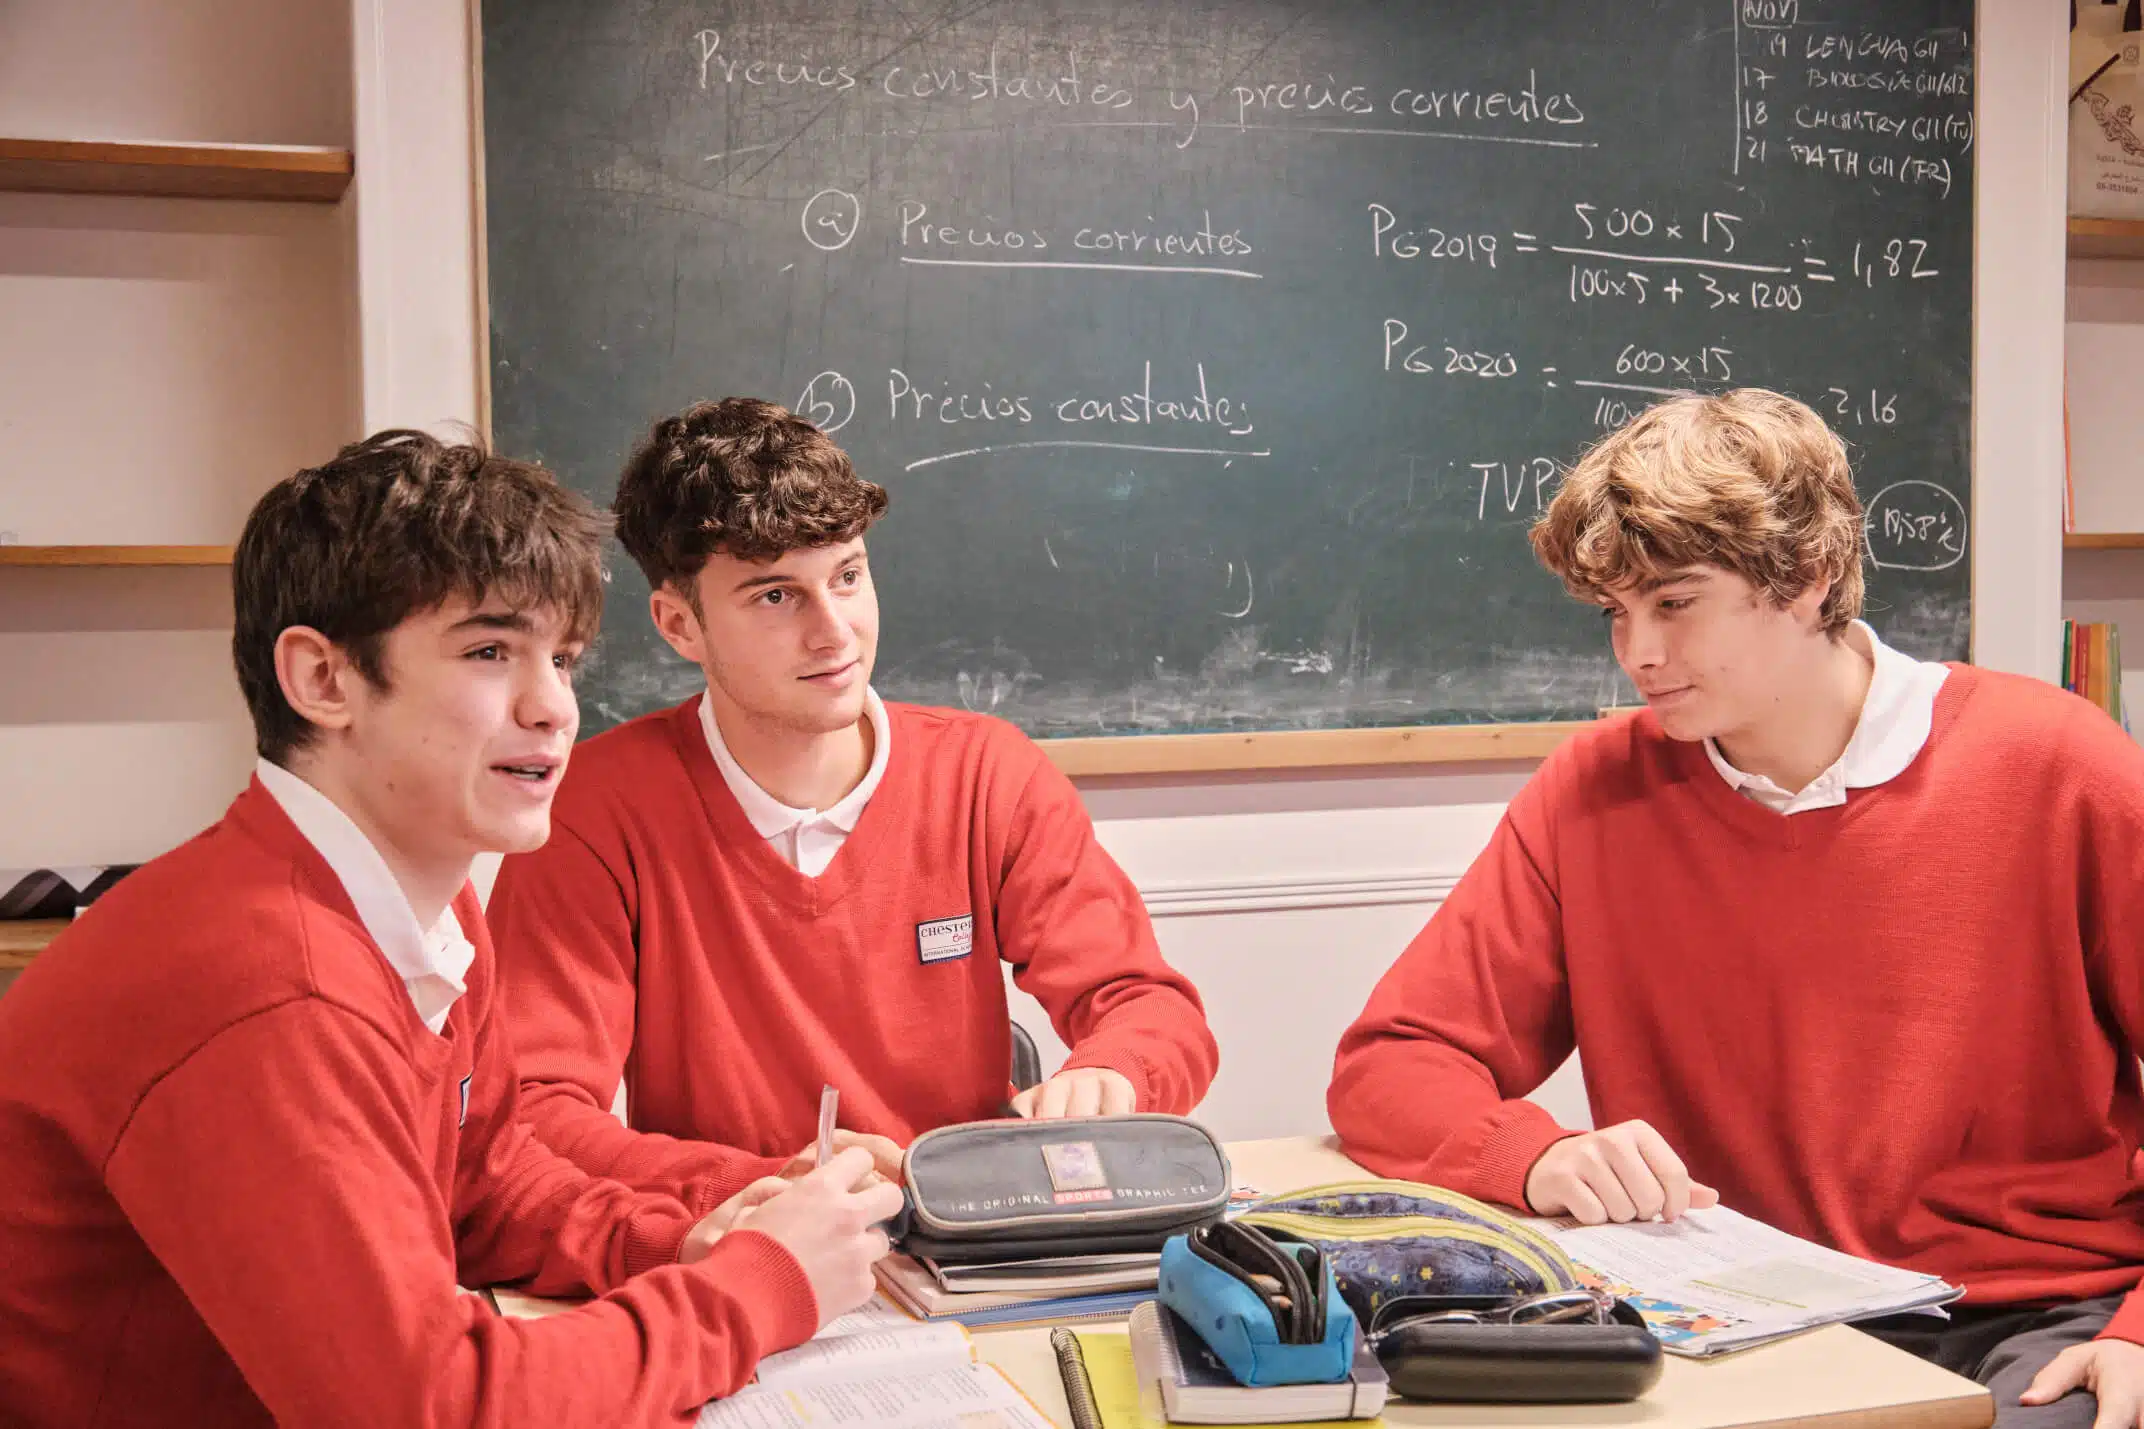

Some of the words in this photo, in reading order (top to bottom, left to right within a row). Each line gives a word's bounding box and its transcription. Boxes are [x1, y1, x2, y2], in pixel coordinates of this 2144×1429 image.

[693, 29, 856, 91] Precios
[883, 43, 1133, 108] constantes
[1169, 90, 1199, 149] y
[1232, 74, 1373, 133] precios
[1391, 69, 1584, 124] corrientes
[1743, 66, 1776, 91] 17
[1744, 100, 1769, 129] 18
[1746, 136, 1766, 163] 21
[901, 202, 1047, 250] Precios
[1073, 208, 1253, 257] corrientes
[890, 369, 1033, 424] Precios
[1056, 360, 1254, 433] constantes
[983, 1194, 1049, 1210] ORIGINAL
